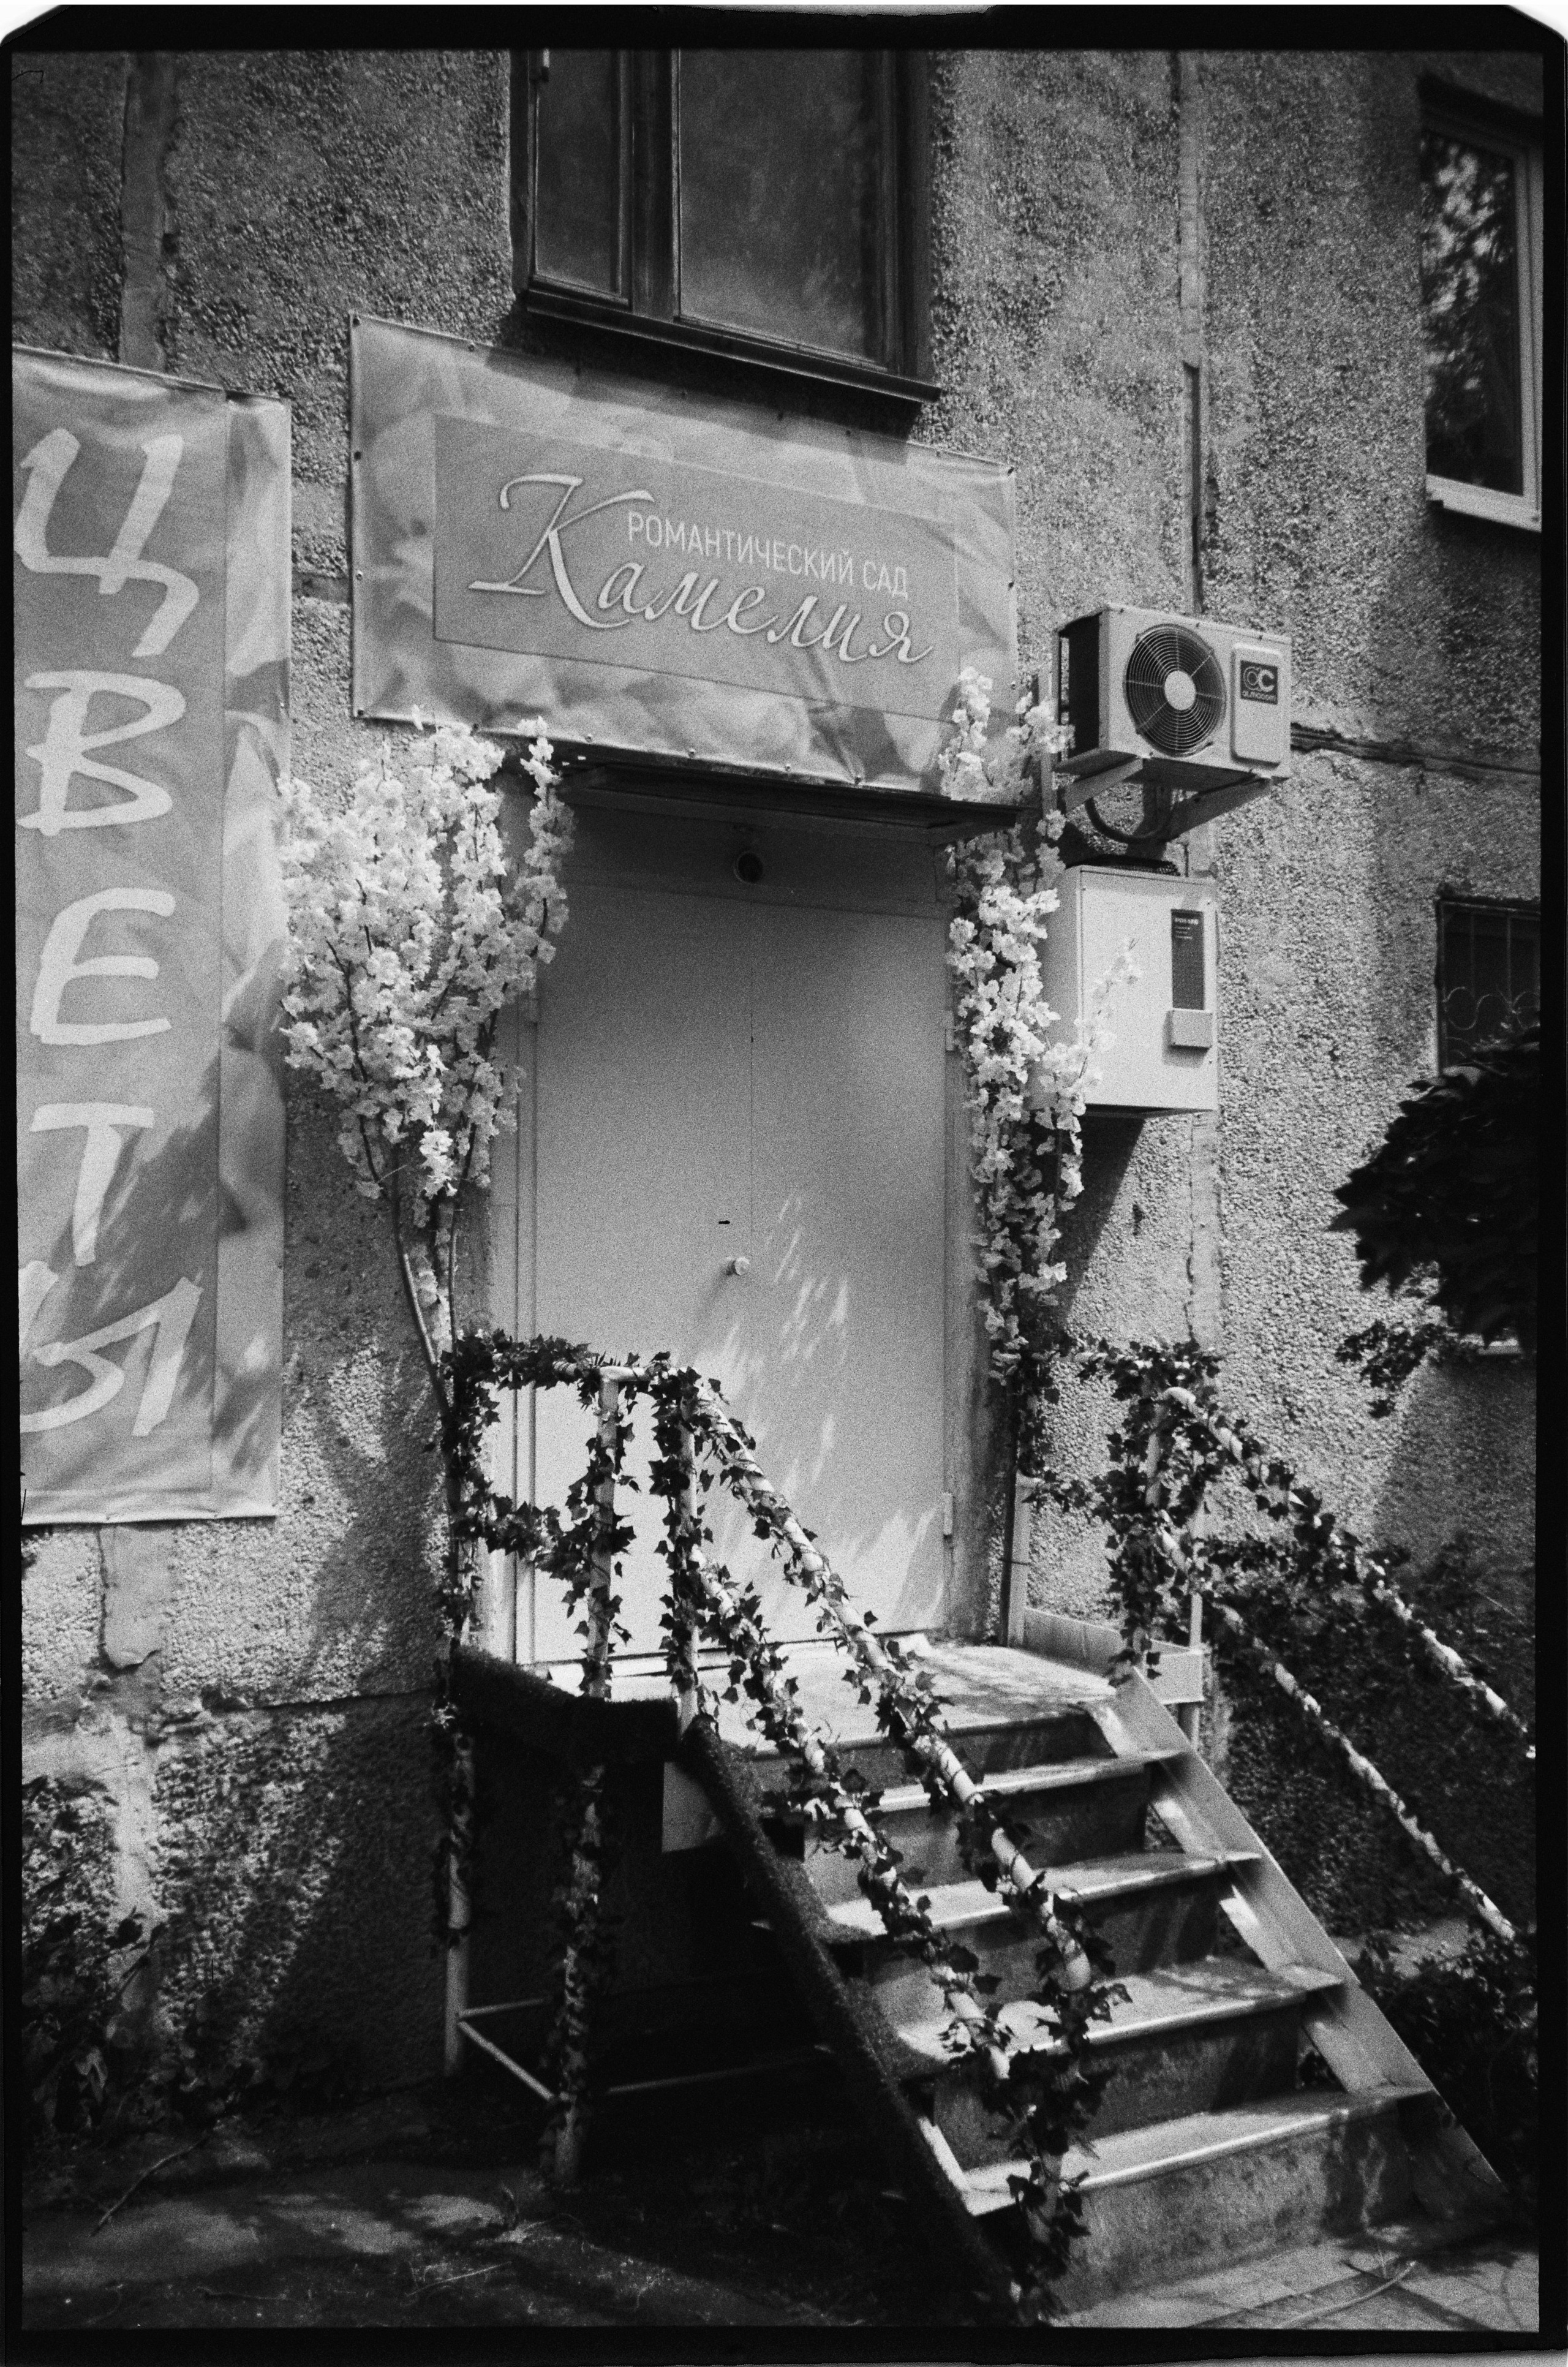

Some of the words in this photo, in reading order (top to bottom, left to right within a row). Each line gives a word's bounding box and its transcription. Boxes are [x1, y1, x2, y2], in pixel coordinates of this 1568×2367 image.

[469, 474, 933, 663] Камелия
[628, 511, 854, 586] РОМАНТИЧЕСКИЙ
[862, 561, 908, 599] САД
[14, 428, 202, 1436] ЦВЕТЫ
